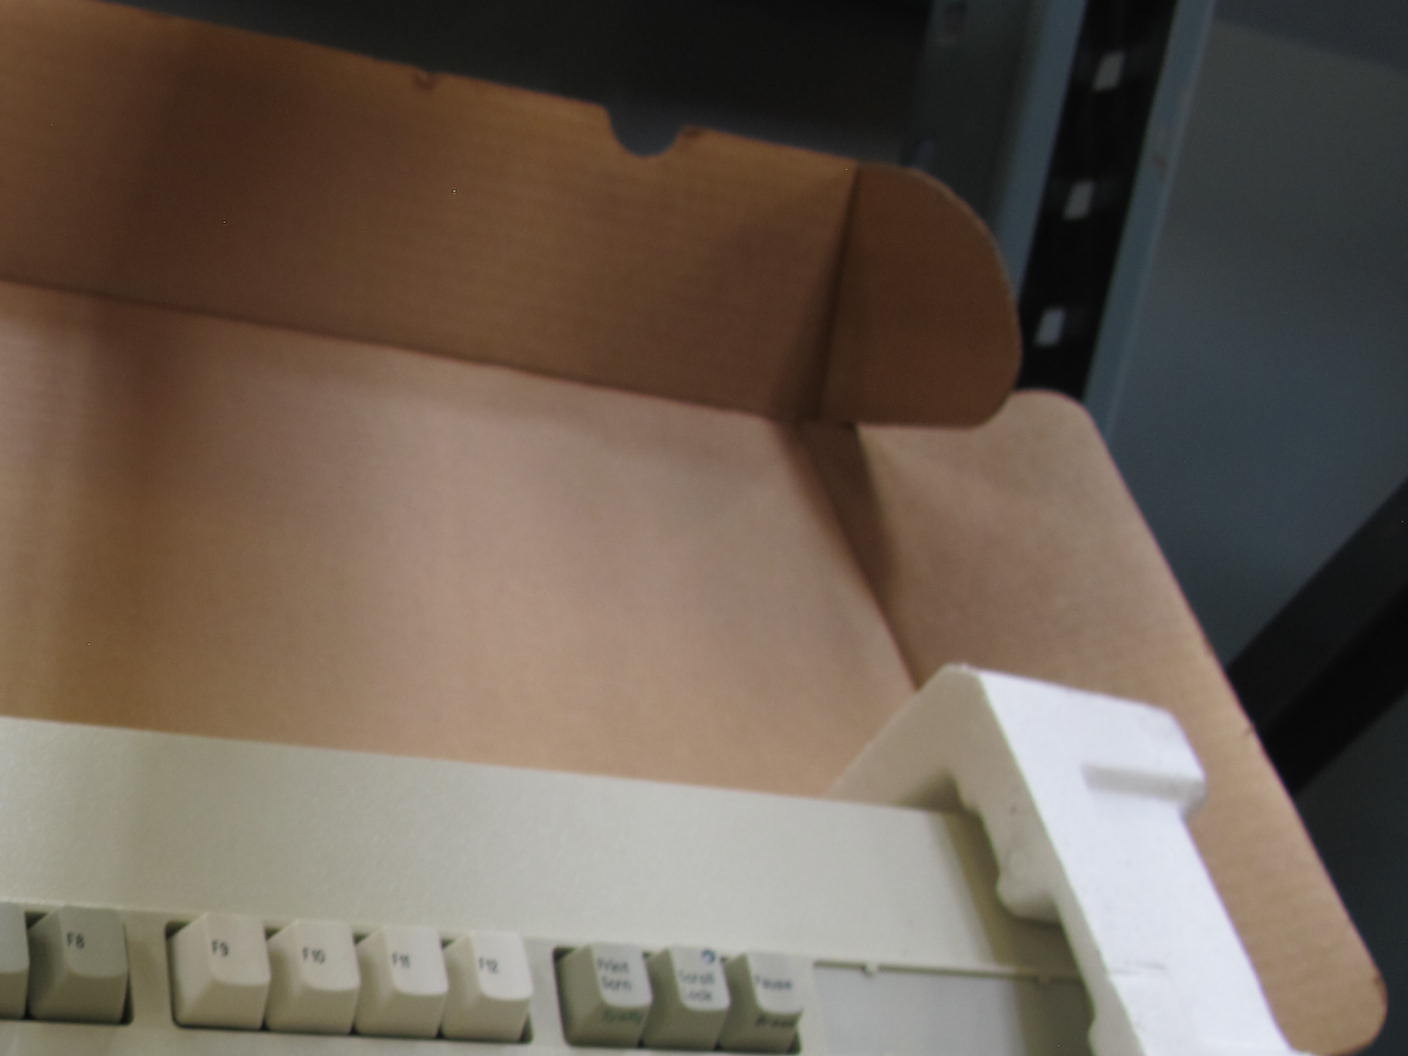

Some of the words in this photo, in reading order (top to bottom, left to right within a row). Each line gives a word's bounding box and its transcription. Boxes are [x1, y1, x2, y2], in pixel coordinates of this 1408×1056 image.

[66, 931, 85, 950] F8
[211, 939, 230, 957] F9
[302, 946, 326, 965] F10
